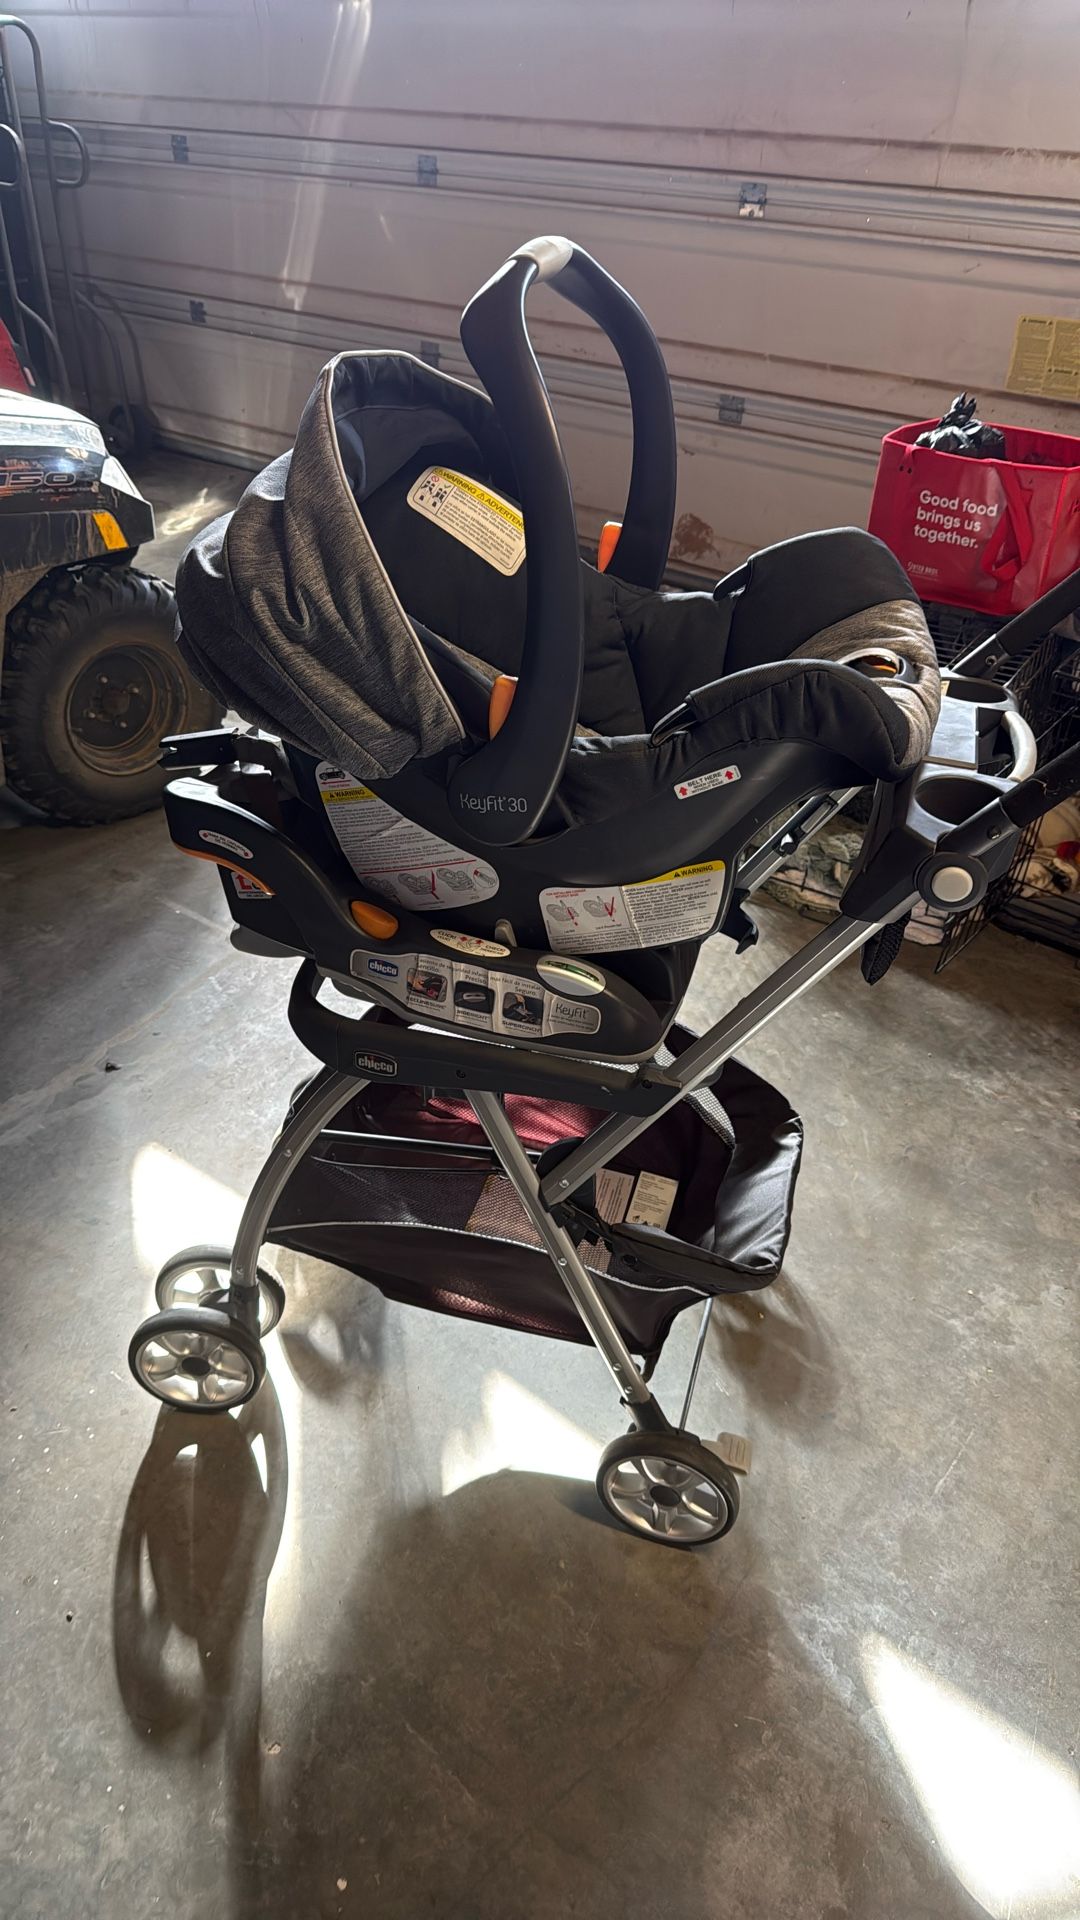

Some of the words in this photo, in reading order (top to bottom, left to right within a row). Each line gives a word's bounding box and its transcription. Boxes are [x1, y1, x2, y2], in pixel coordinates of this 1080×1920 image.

[443, 471, 477, 495] WARNING
[920, 490, 960, 510] Good
[962, 499, 999, 517] food
[916, 506, 961, 530] brings
[964, 519, 981, 532] us
[913, 524, 979, 549] together.
[687, 777, 704, 787] BELT
[704, 772, 723, 782] HERE
[335, 788, 366, 799] WARNING
[507, 797, 528, 813] 30
[680, 864, 714, 877] WARNING
[369, 960, 398, 976] chicco
[358, 1055, 394, 1073] chicco
